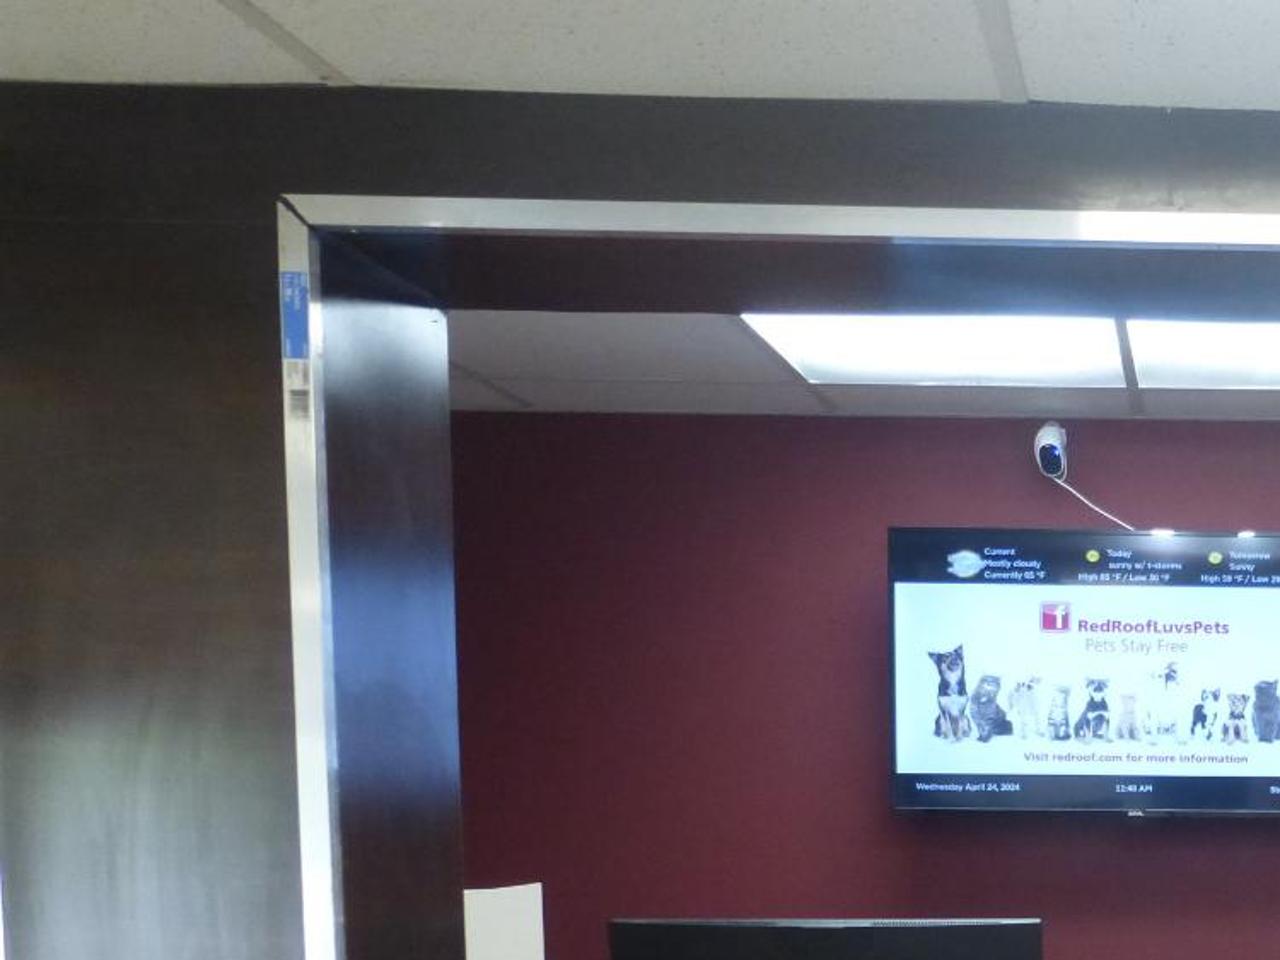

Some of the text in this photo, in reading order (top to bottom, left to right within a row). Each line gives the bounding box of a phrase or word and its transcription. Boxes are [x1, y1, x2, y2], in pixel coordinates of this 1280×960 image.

[1105, 549, 1132, 559] Today
[984, 559, 1041, 569] Mostly cloudy
[984, 571, 1022, 580] Currently
[1078, 573, 1098, 582] High
[1129, 573, 1147, 581] Low
[1201, 575, 1220, 584] High
[1251, 575, 1269, 583] Low
[1078, 619, 1230, 634] RedRoofLuvsPets
[1085, 638, 1189, 655] Pets Stay Free
[1024, 752, 1248, 764] Visit redroof.com for more information
[916, 783, 963, 792] Wednesday
[965, 783, 985, 792] April
[1000, 783, 1020, 791] 2024
